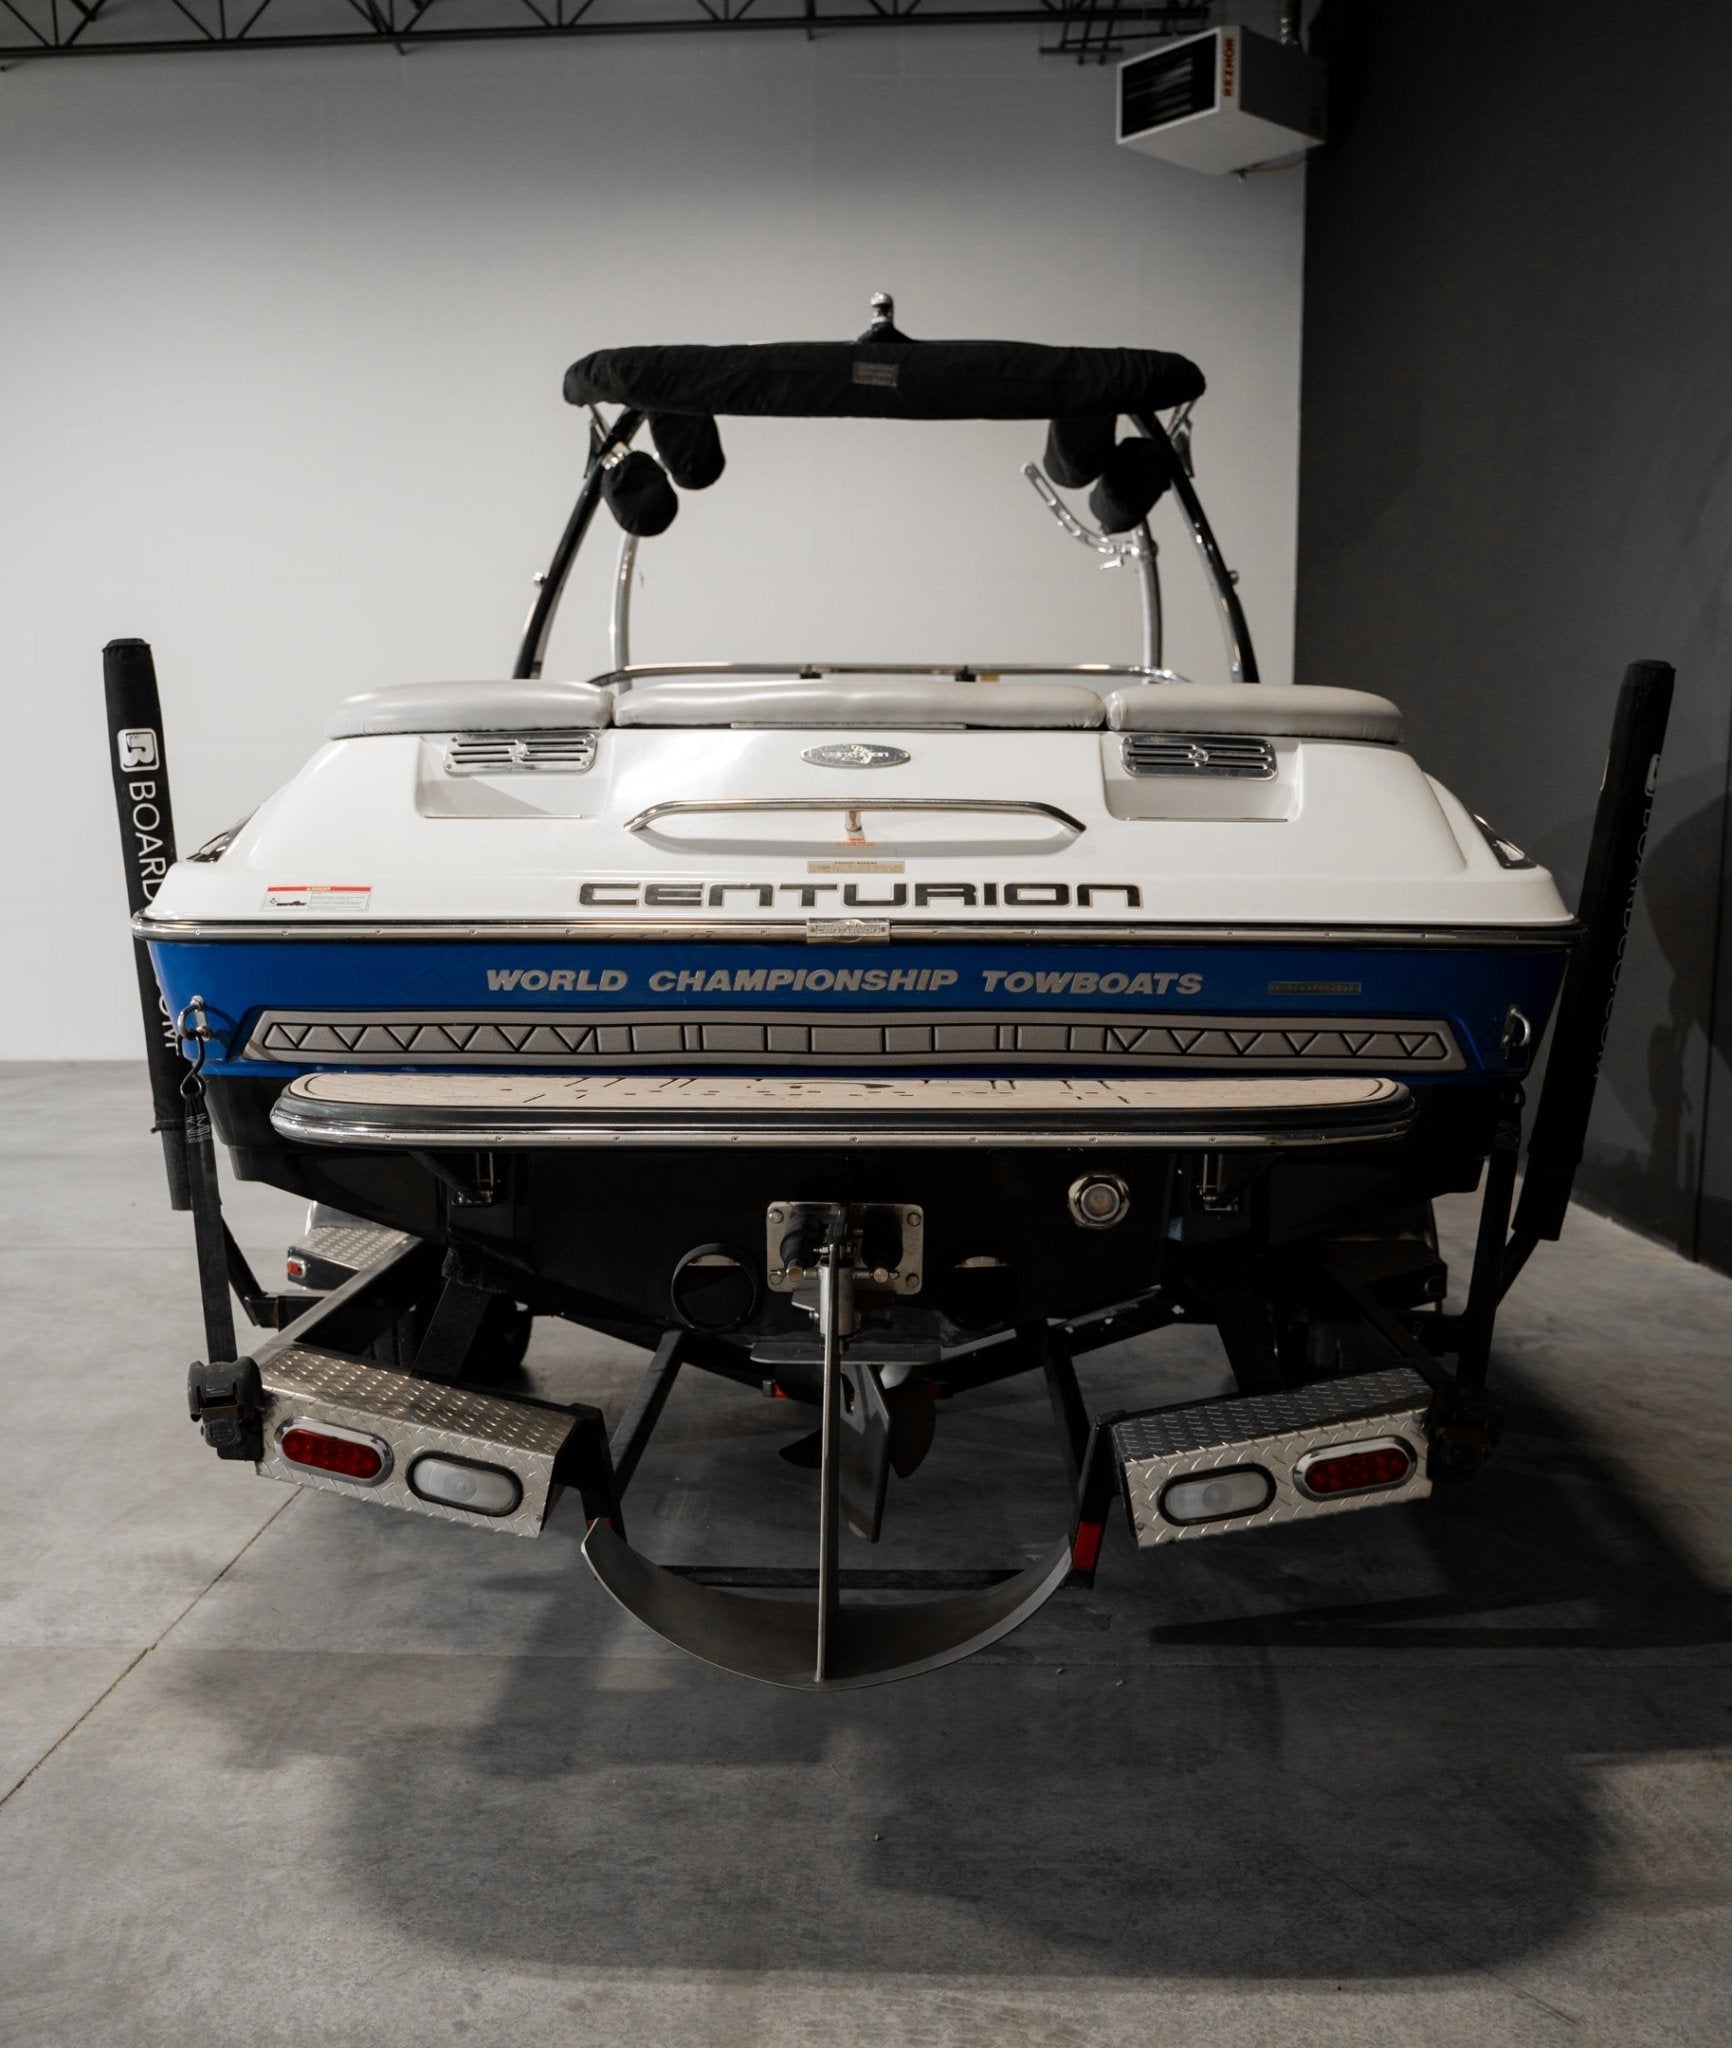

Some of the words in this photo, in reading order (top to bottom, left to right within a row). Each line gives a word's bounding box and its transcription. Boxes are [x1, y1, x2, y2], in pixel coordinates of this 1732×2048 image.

[579, 882, 1142, 907] CENTURION
[486, 969, 628, 991] WORLD
[649, 968, 959, 992] CHAMPIONSHIP
[982, 969, 1204, 994] TOWBOATS
